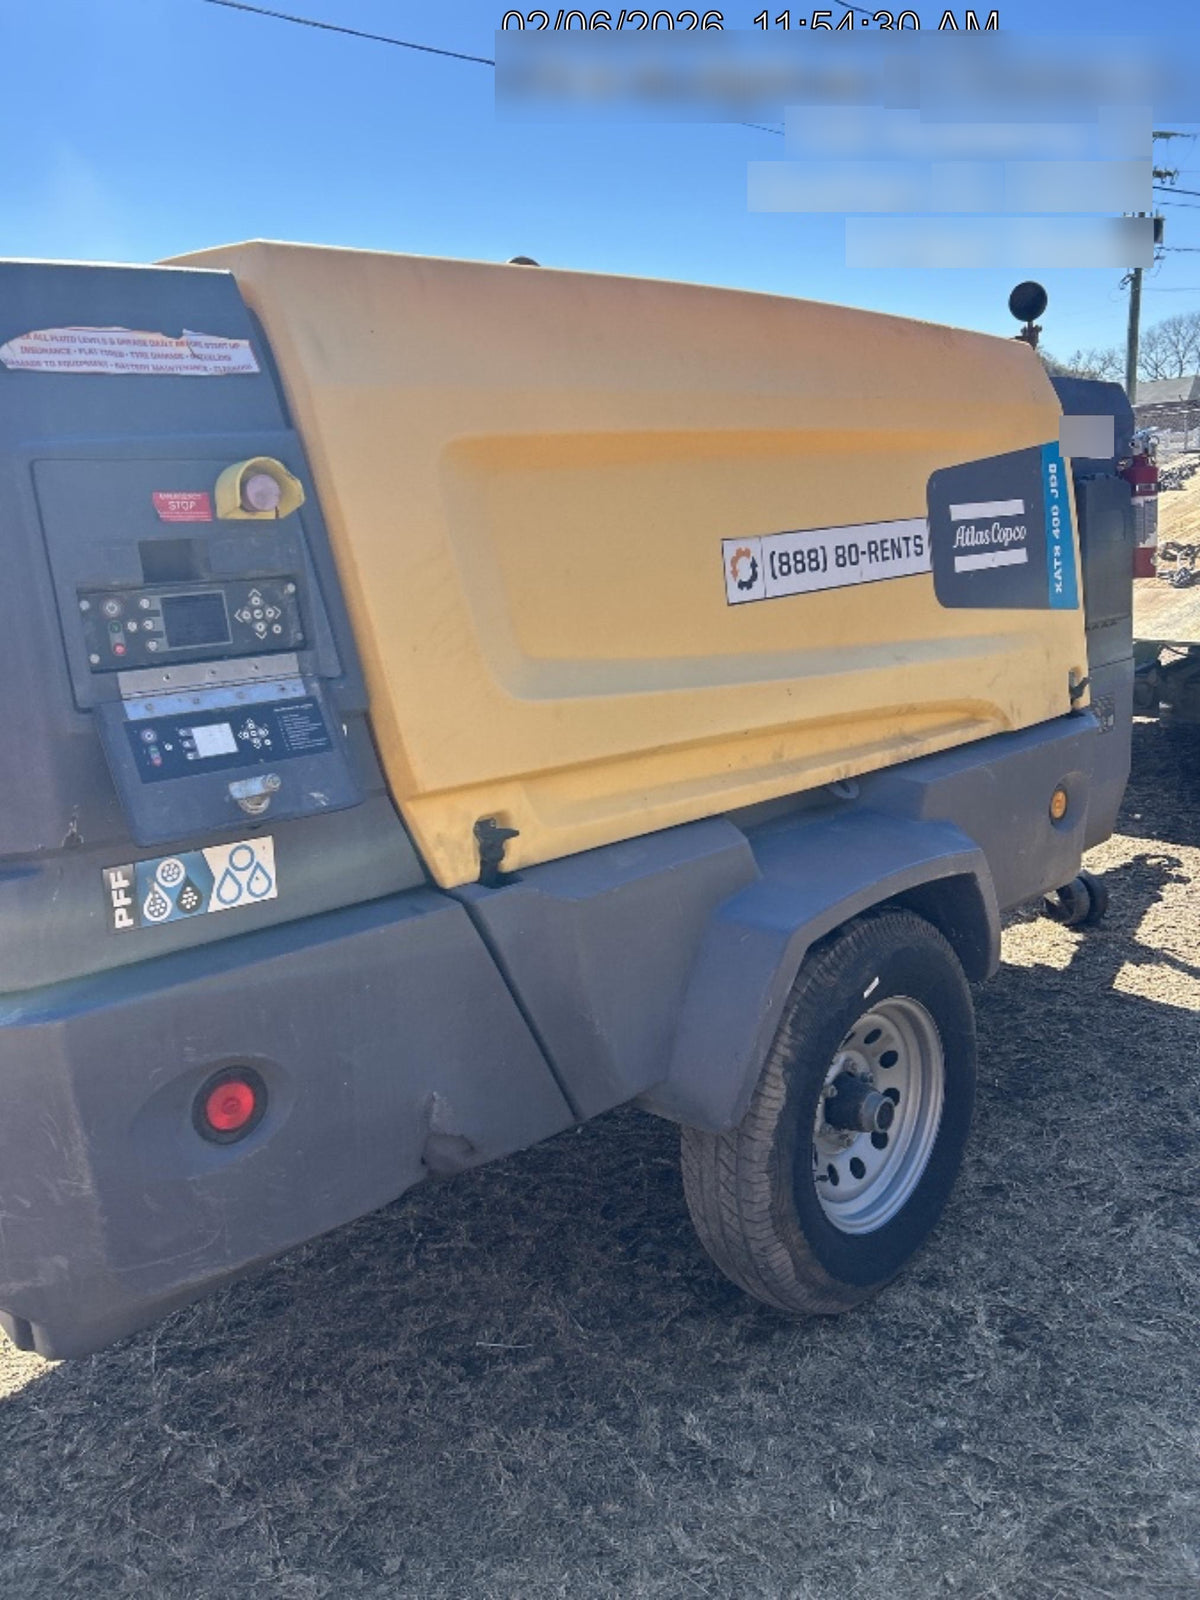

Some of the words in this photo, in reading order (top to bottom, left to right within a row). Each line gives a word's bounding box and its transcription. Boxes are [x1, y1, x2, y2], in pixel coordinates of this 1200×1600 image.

[167, 500, 197, 511] STOP
[1050, 505, 1061, 540] 400
[953, 524, 990, 549] Atlas
[991, 522, 1027, 546] Copco
[769, 544, 828, 579] (888)
[835, 535, 924, 568] 80-RENTS
[109, 870, 134, 929] PFF
